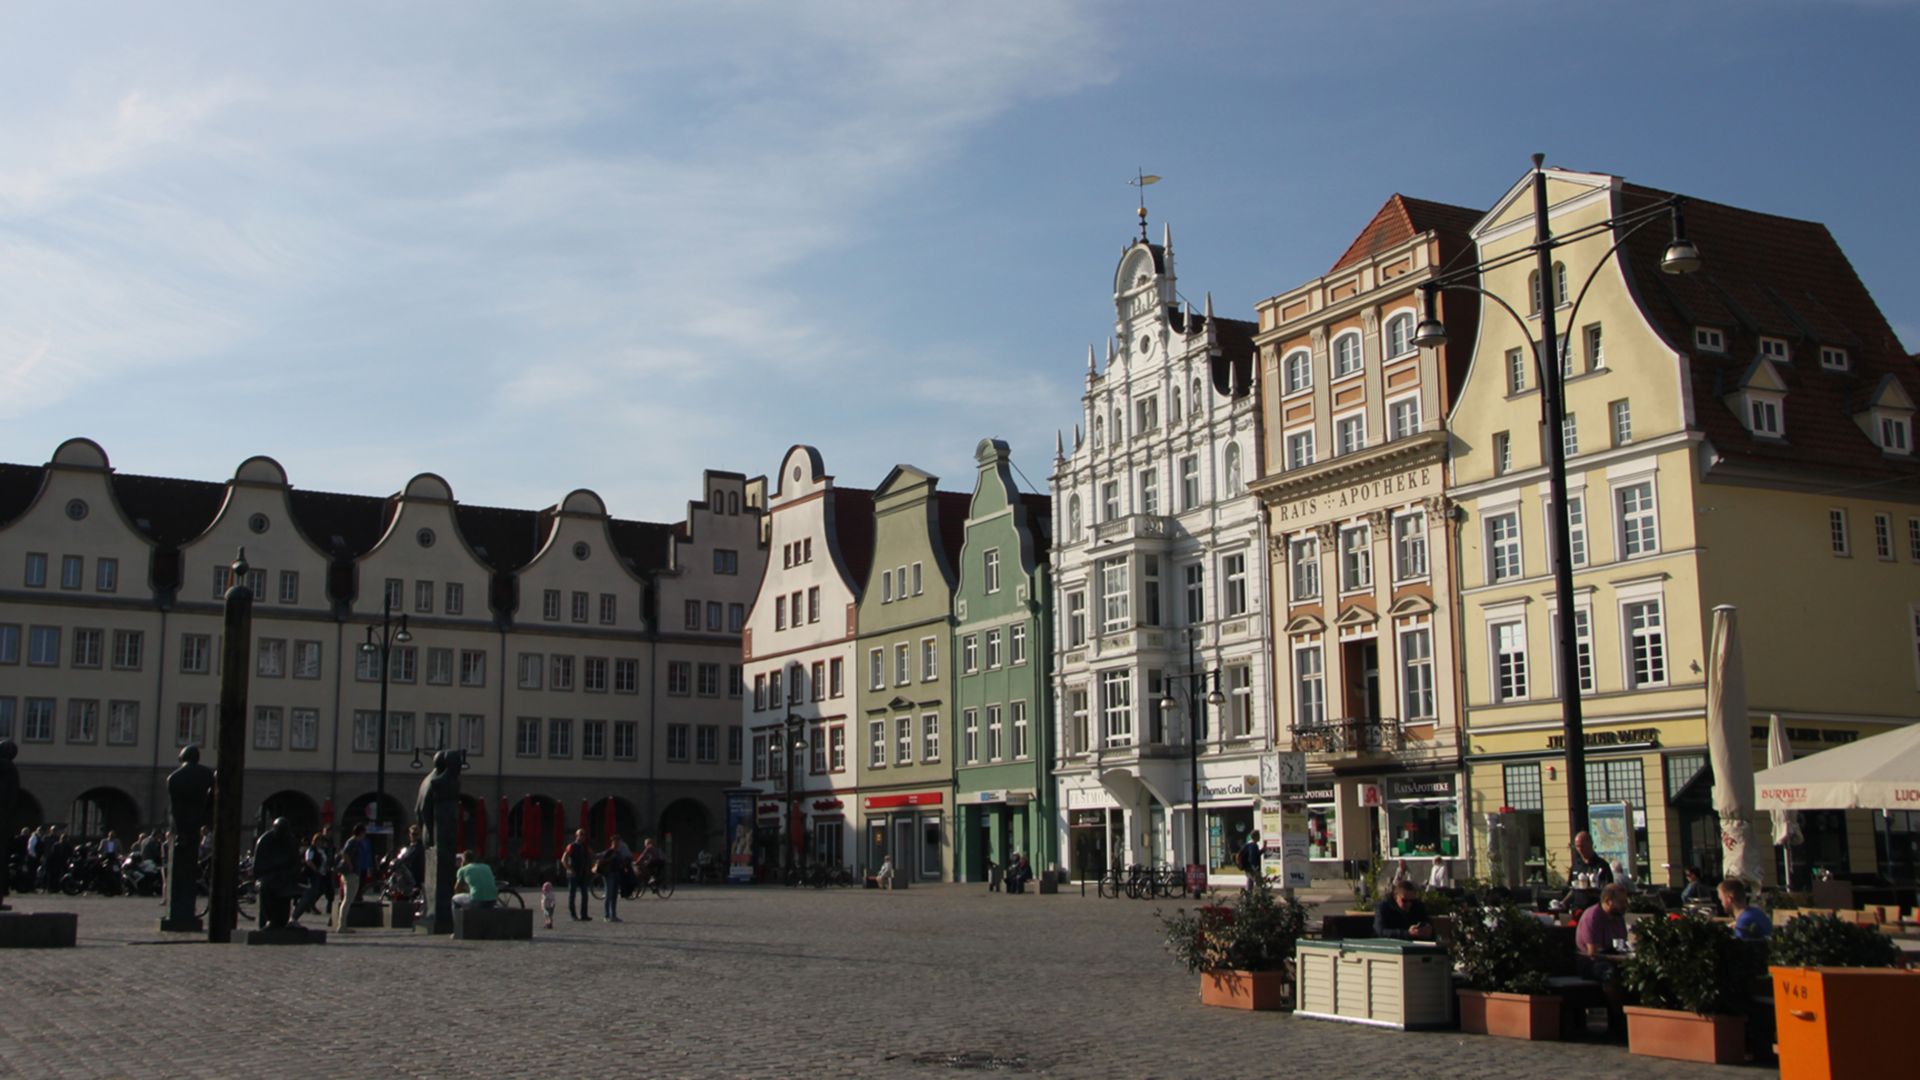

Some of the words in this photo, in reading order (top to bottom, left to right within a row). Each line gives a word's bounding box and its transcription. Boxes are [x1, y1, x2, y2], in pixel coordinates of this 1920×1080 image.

[1280, 498, 1317, 521] RATS
[1339, 468, 1431, 507] APOTHEKE
[1792, 984, 1808, 999] 48
